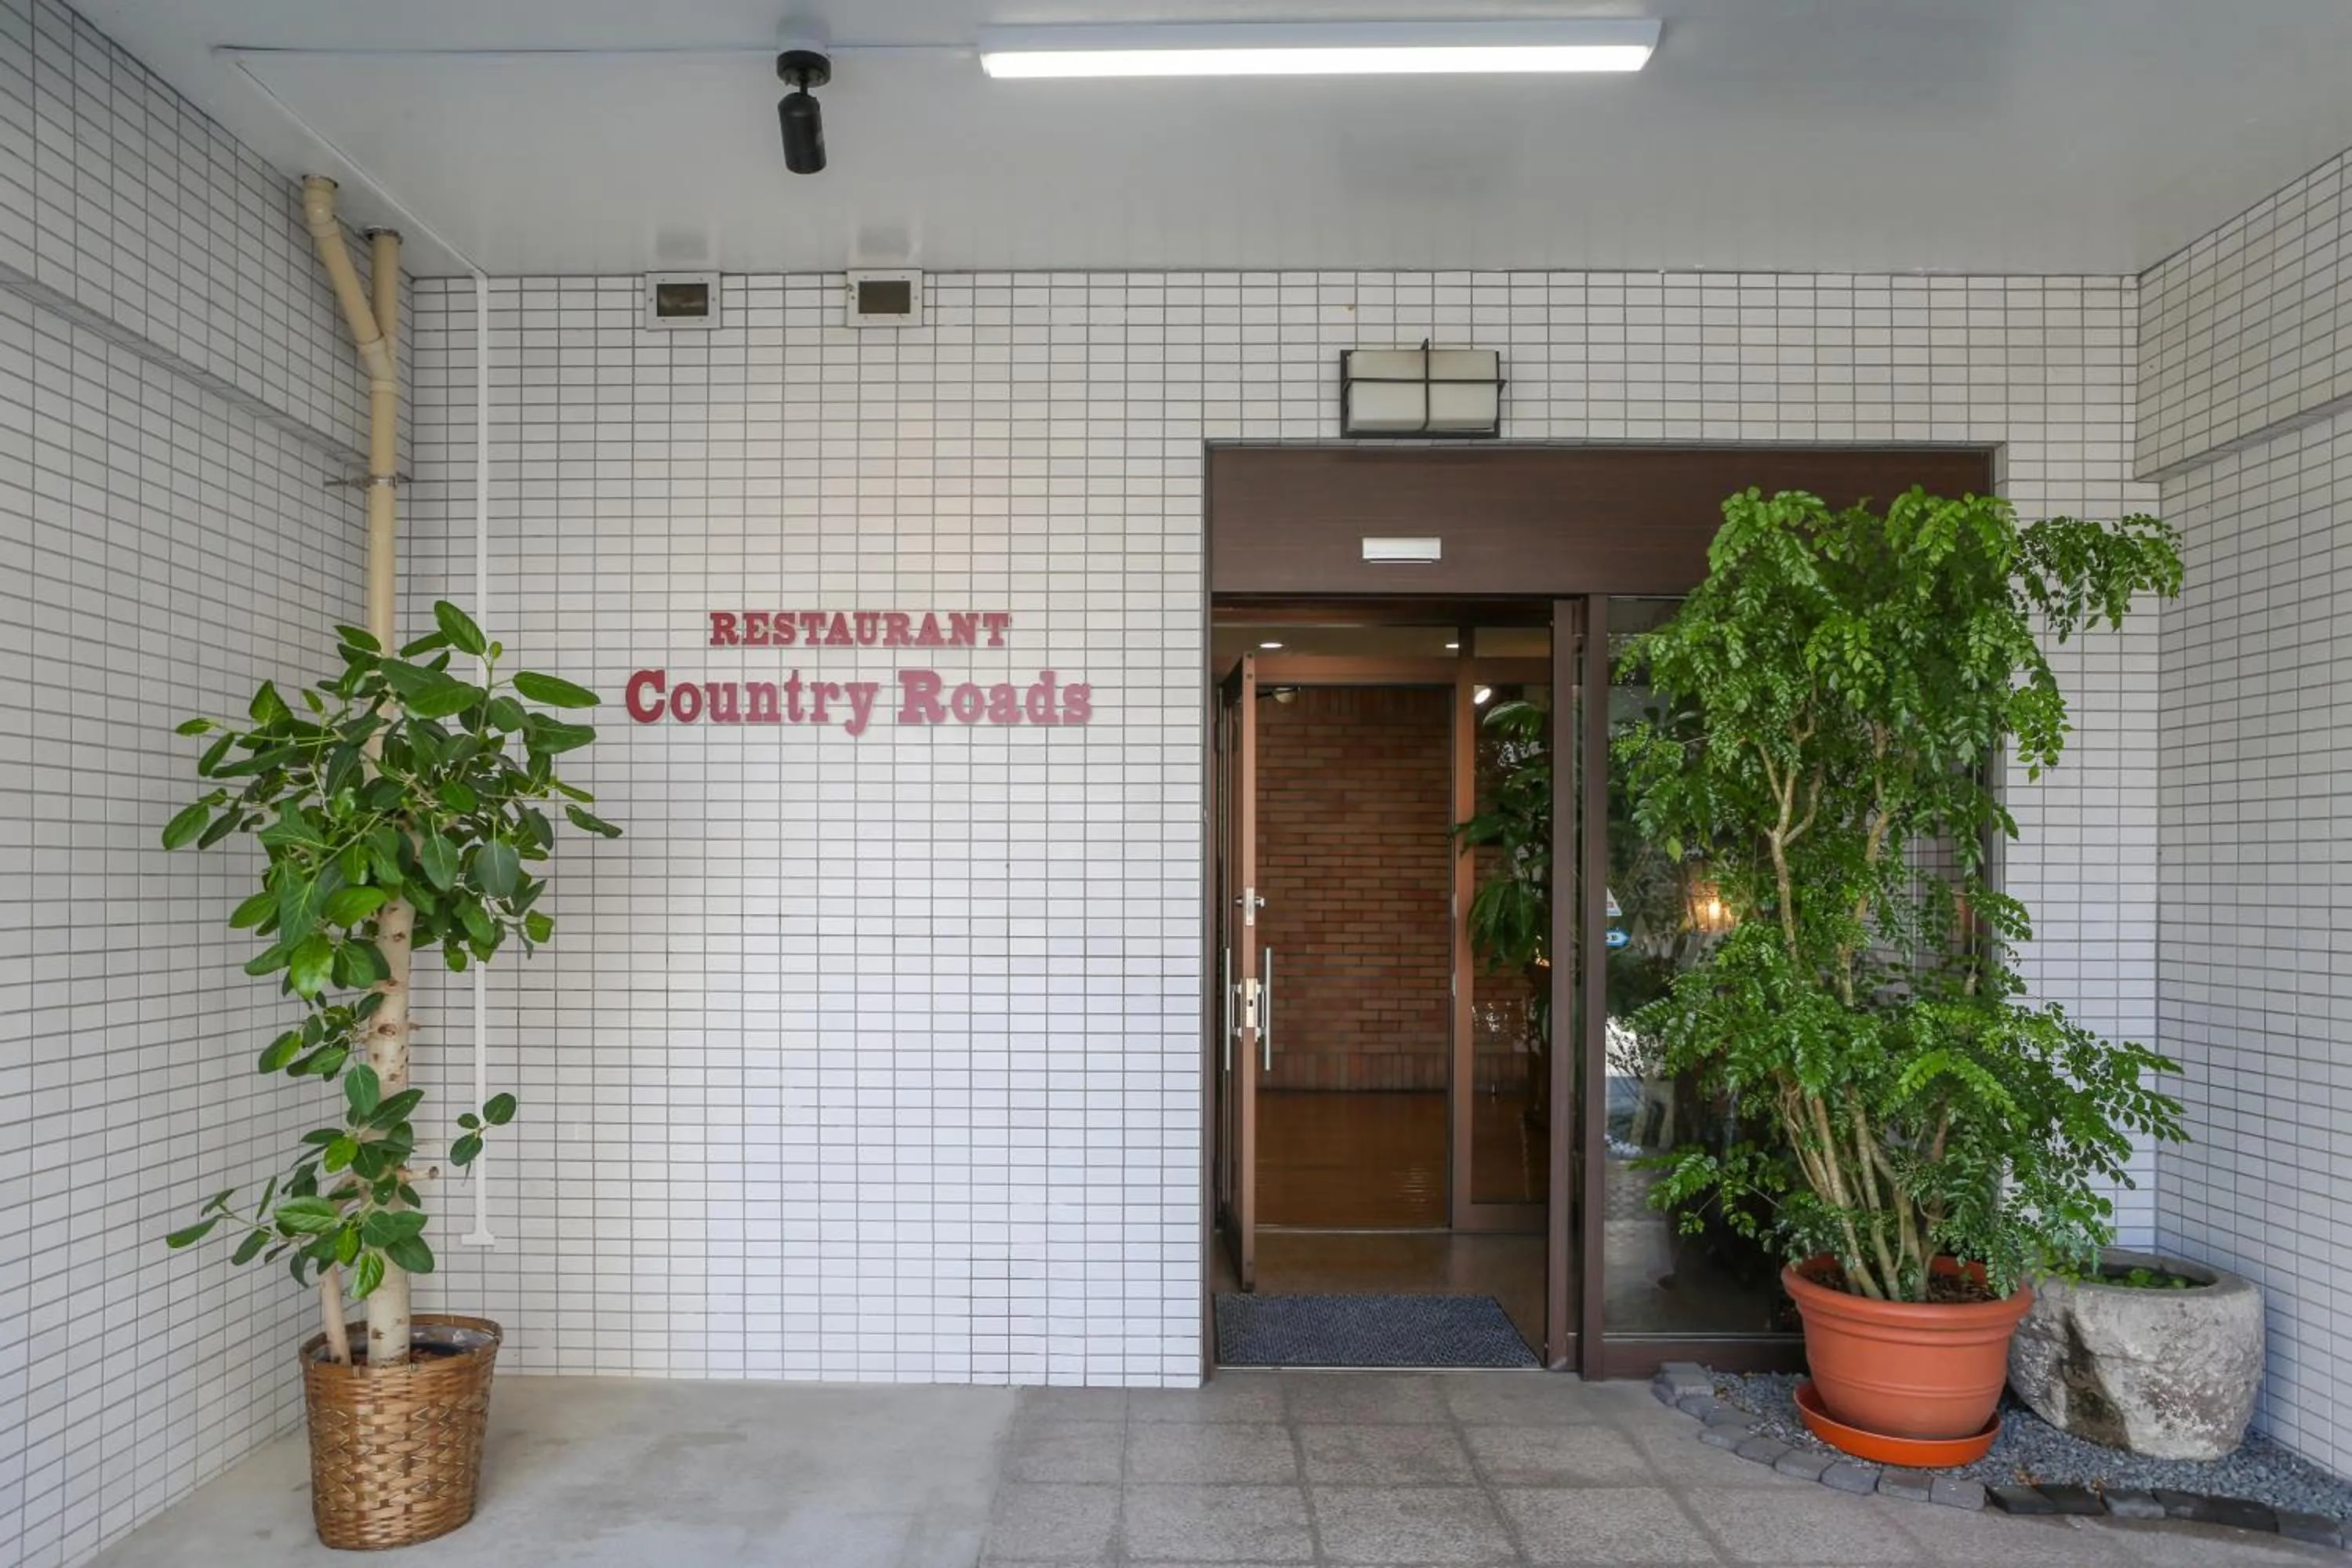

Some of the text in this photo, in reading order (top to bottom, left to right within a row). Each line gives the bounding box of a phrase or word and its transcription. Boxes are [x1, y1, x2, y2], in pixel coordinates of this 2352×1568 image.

[709, 610, 1011, 648] RESTAURANT
[626, 670, 1091, 736] Country Roads
